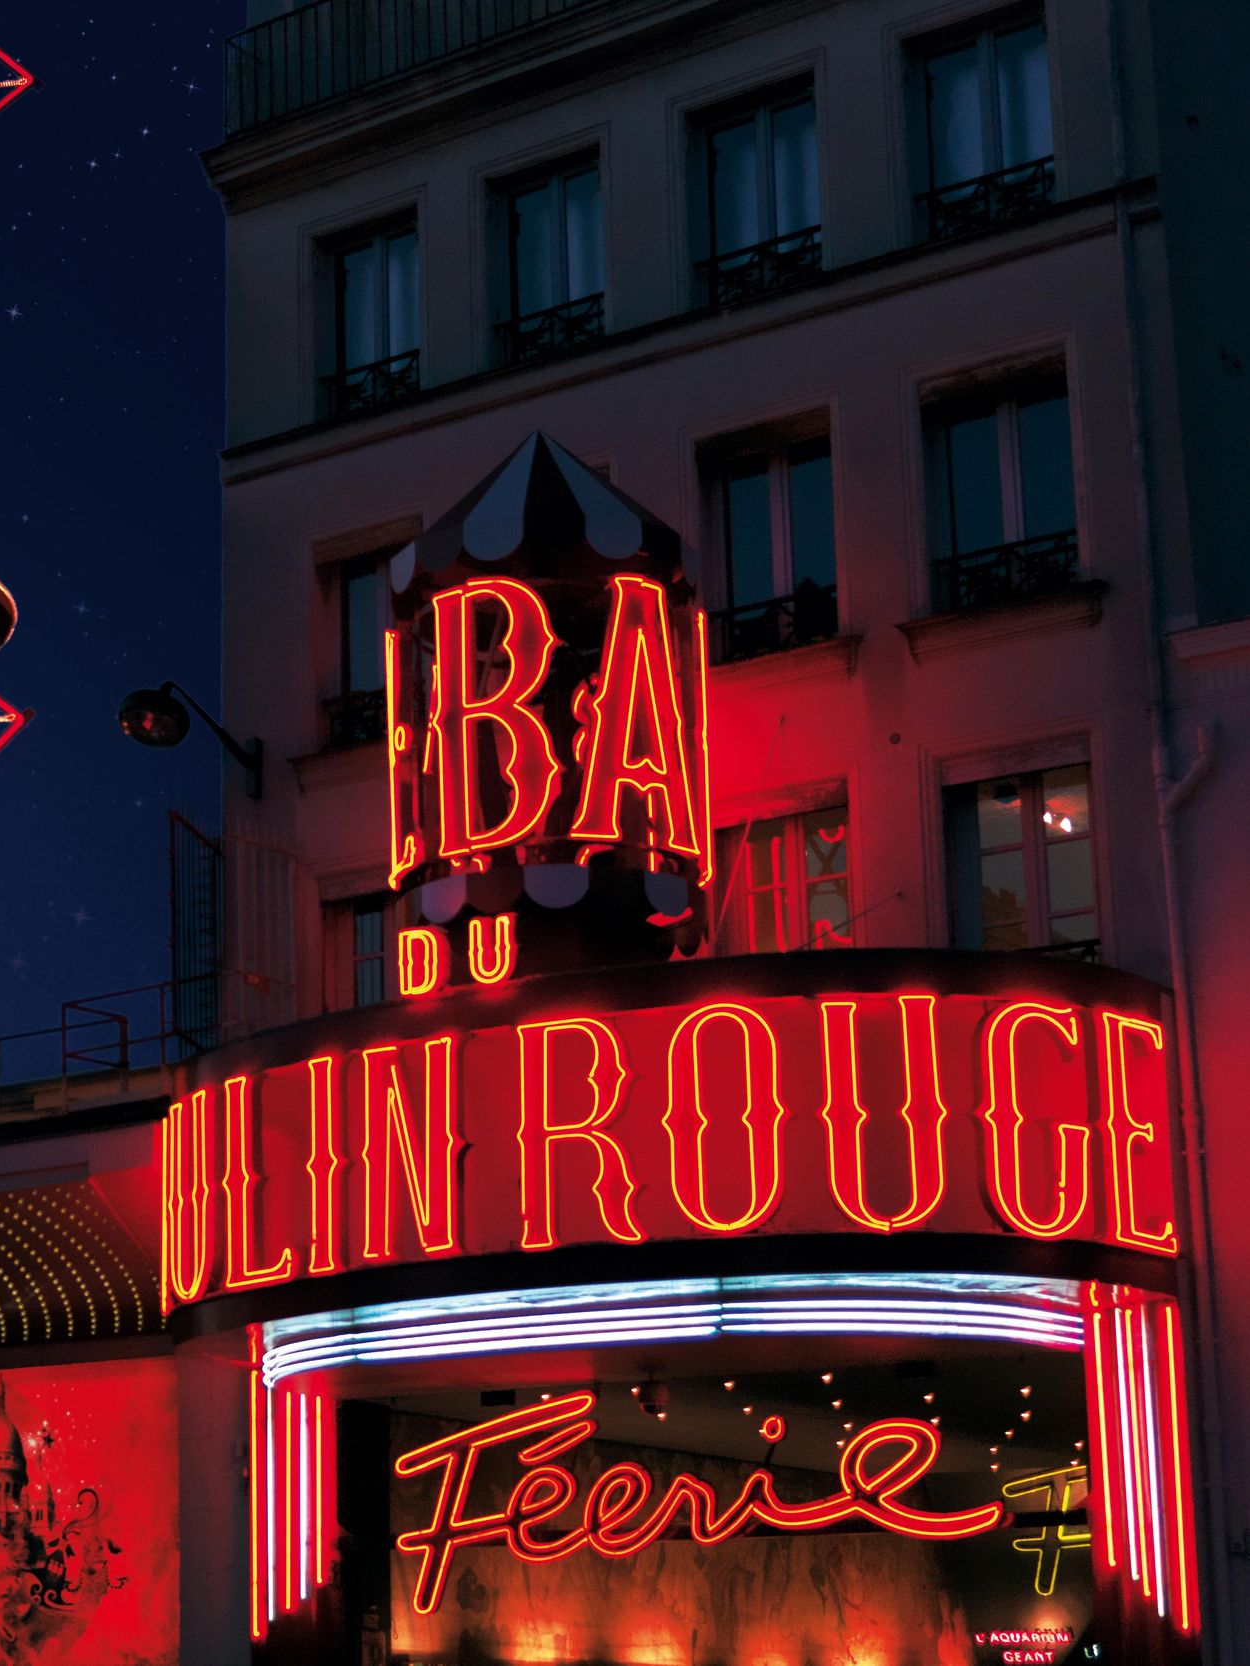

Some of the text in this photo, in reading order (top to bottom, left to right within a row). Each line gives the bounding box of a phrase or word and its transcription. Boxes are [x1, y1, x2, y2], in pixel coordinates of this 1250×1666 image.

[397, 911, 515, 997] DU
[160, 994, 1179, 1314] ULIN ROUGE
[395, 1389, 1005, 1615] Féerie
